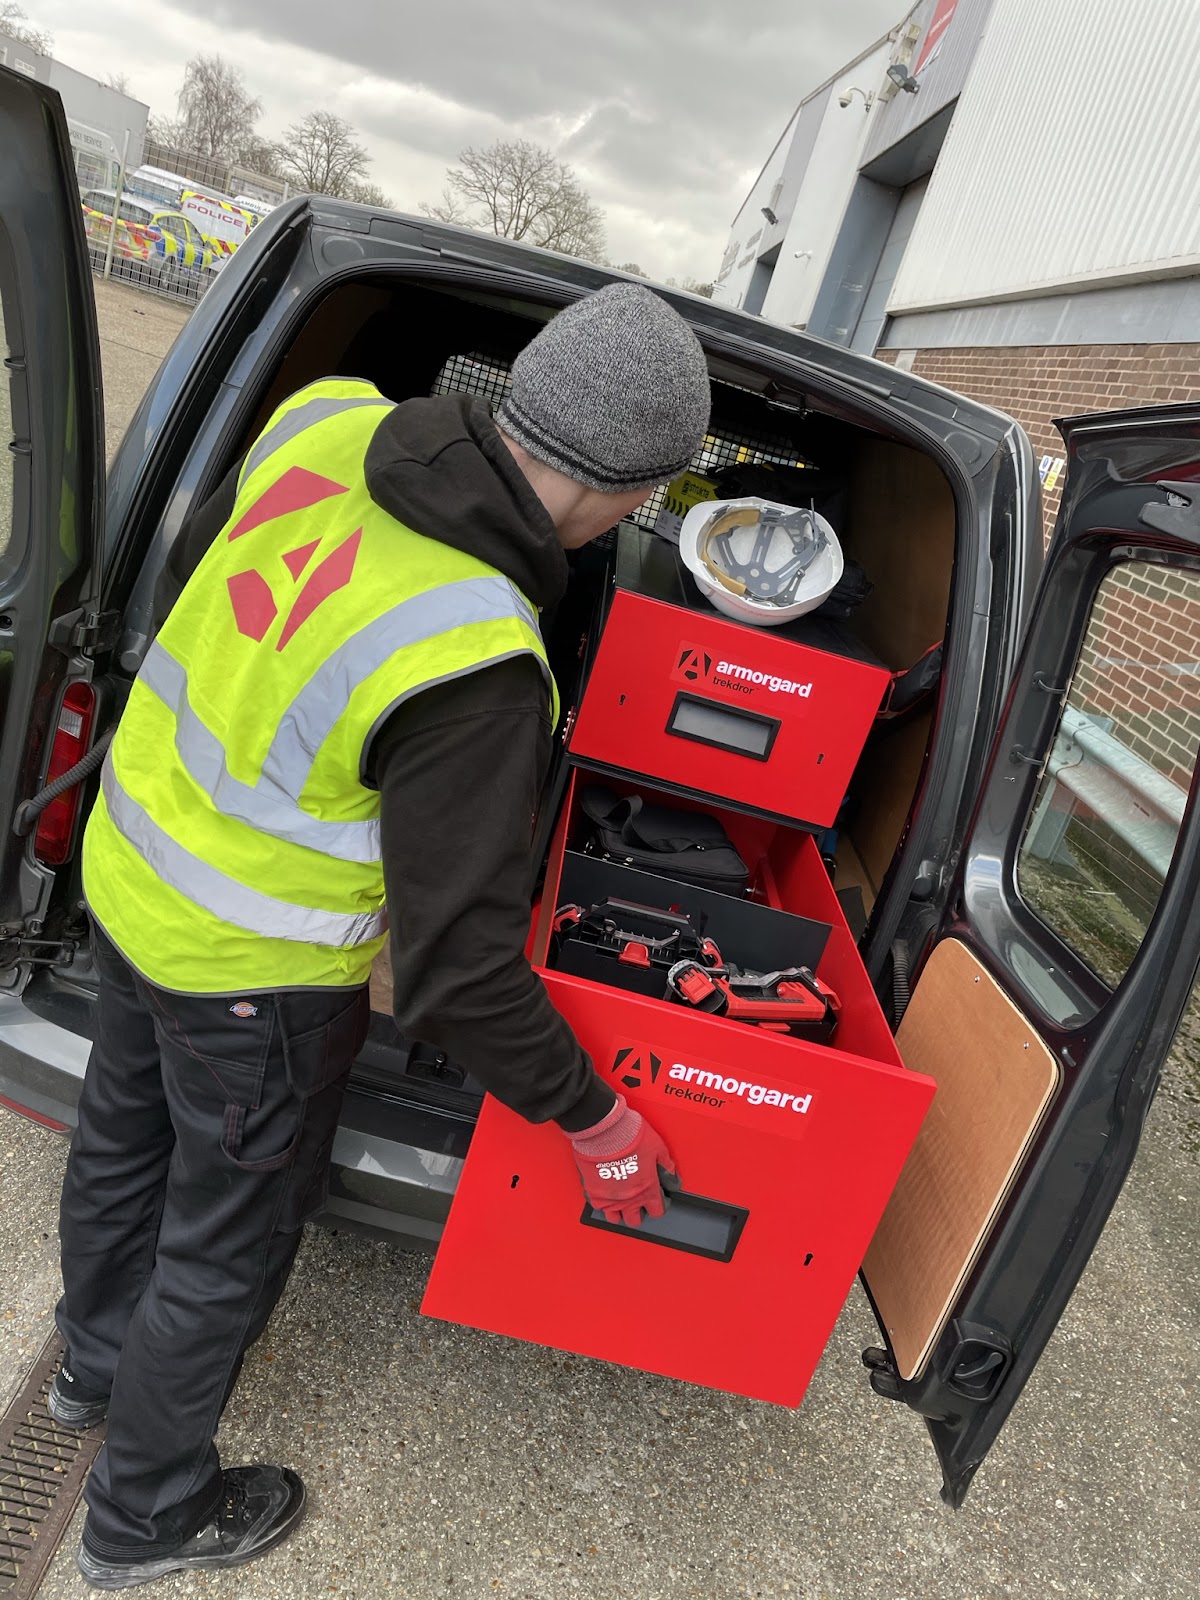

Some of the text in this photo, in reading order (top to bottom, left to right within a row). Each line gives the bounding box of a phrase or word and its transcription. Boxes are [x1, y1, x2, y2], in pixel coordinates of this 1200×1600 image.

[83, 134, 102, 149] SERVICE
[187, 202, 243, 228] POLICE
[713, 676, 754, 695] trekdror
[716, 661, 813, 698] armorgard
[664, 1083, 726, 1108] trekdror
[668, 1063, 813, 1114] armorgard
[598, 1161, 639, 1180] site
